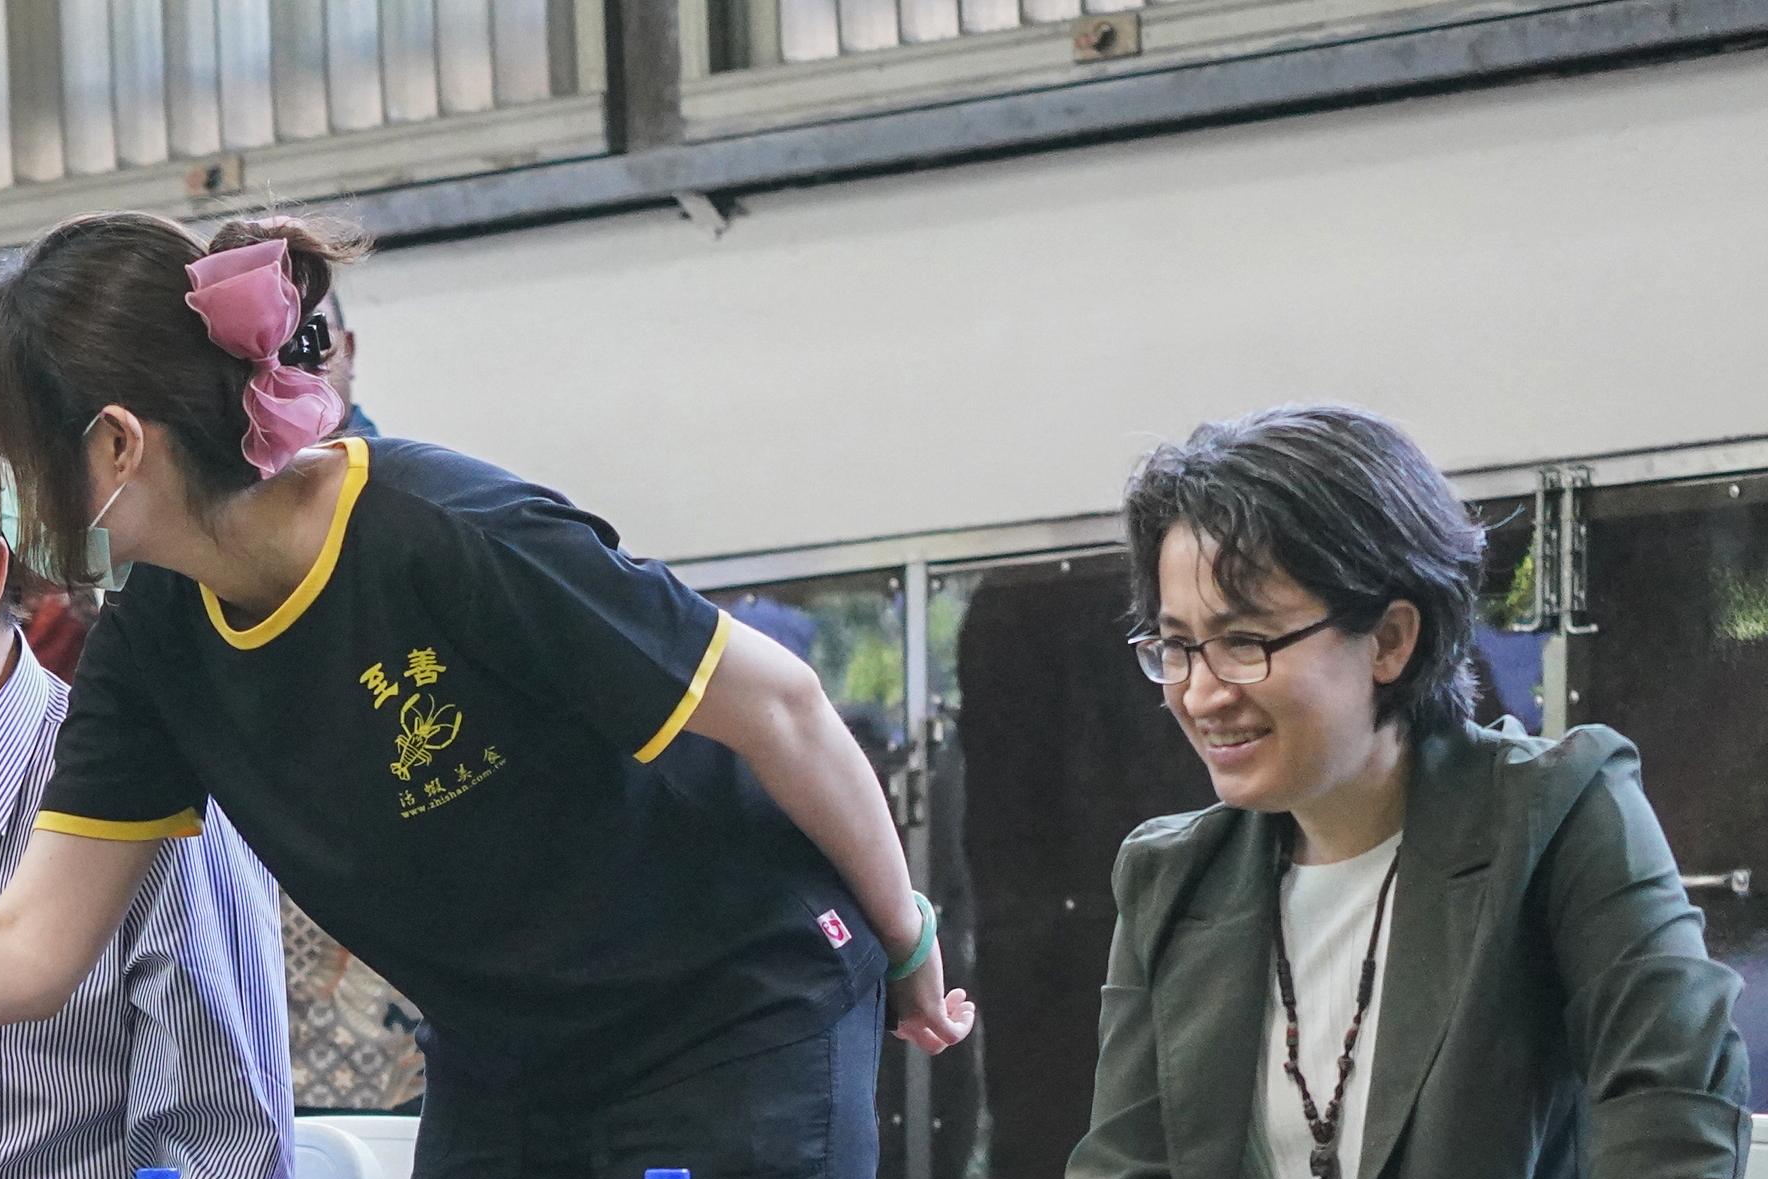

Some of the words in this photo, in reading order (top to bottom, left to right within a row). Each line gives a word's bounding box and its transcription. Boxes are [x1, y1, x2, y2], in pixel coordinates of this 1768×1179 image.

[359, 646, 447, 710] 至善
[398, 745, 501, 808] 活蝦美食
